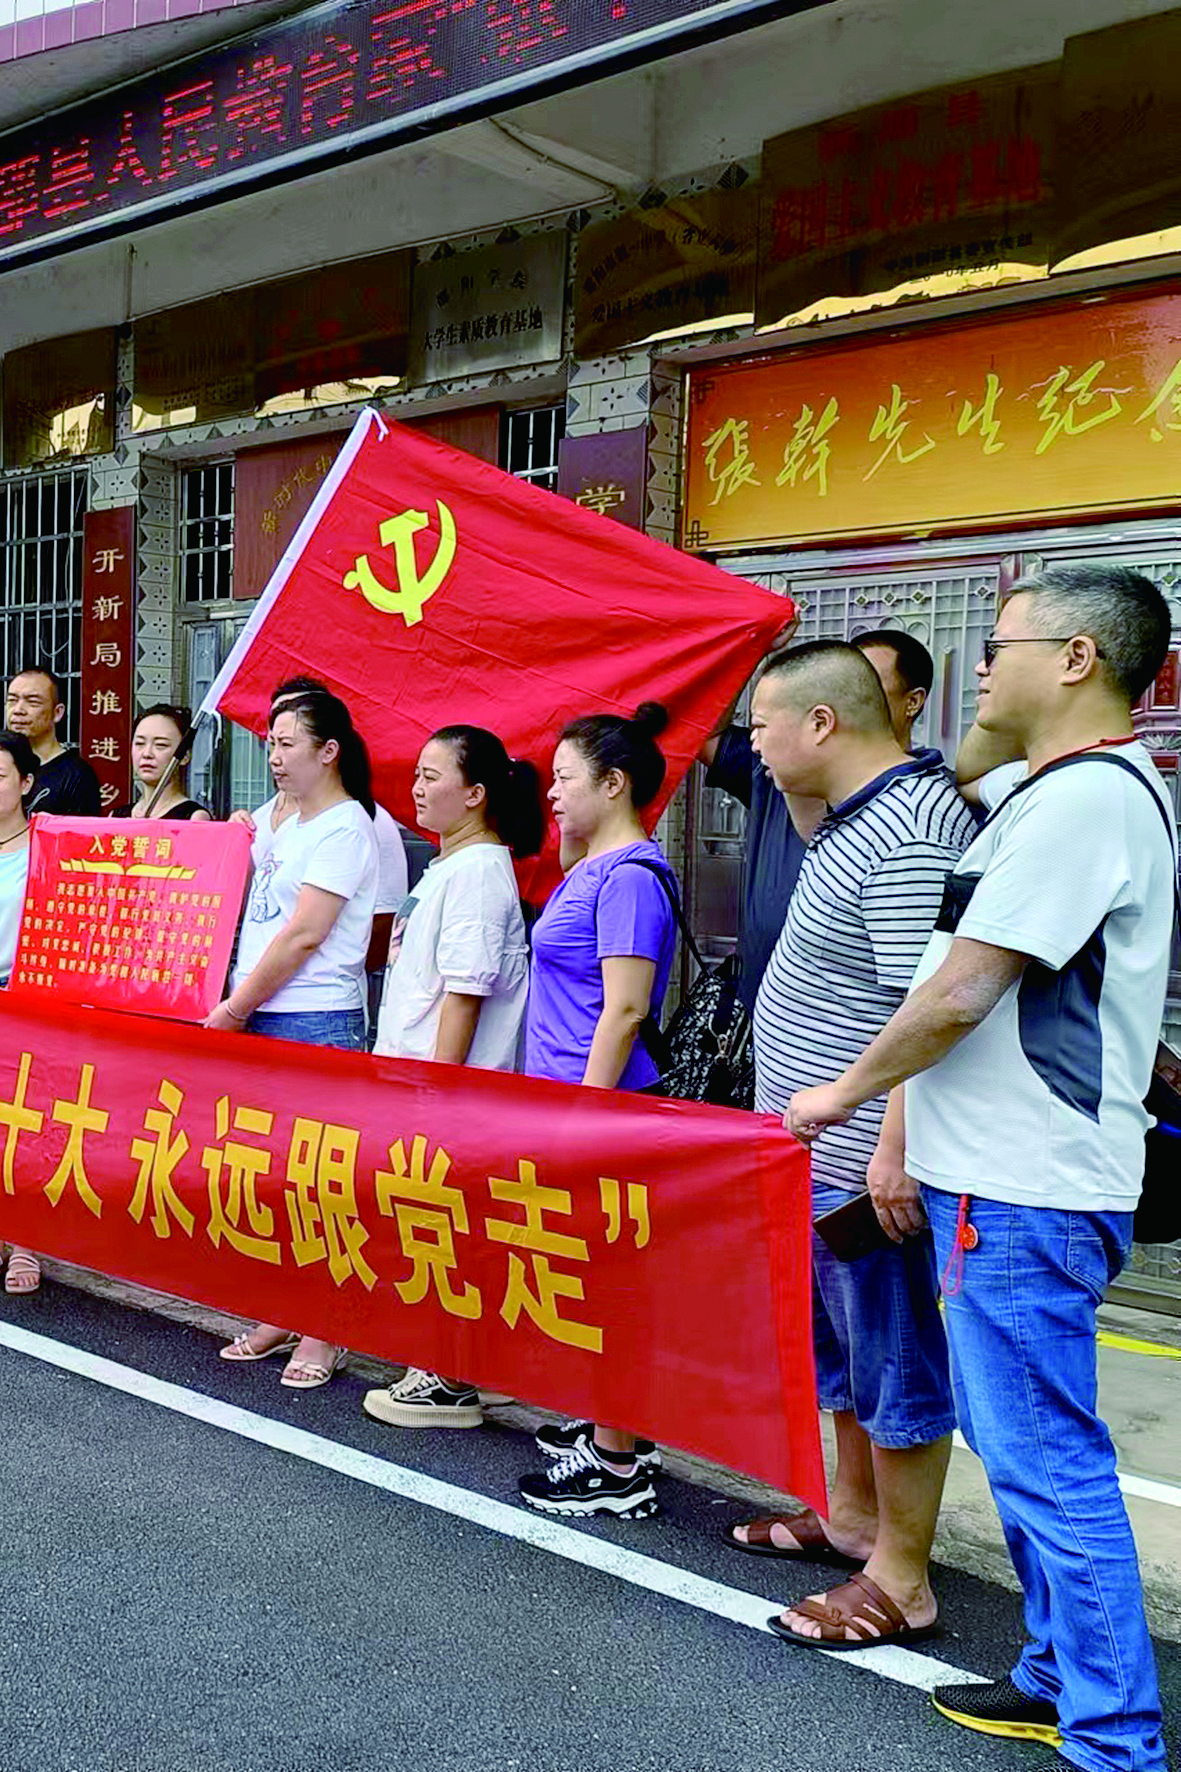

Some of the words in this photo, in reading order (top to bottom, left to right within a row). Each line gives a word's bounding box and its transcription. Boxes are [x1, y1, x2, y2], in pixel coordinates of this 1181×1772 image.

[88, 547, 124, 817] 开新局推进乡
[88, 834, 173, 861] 入党誓词
